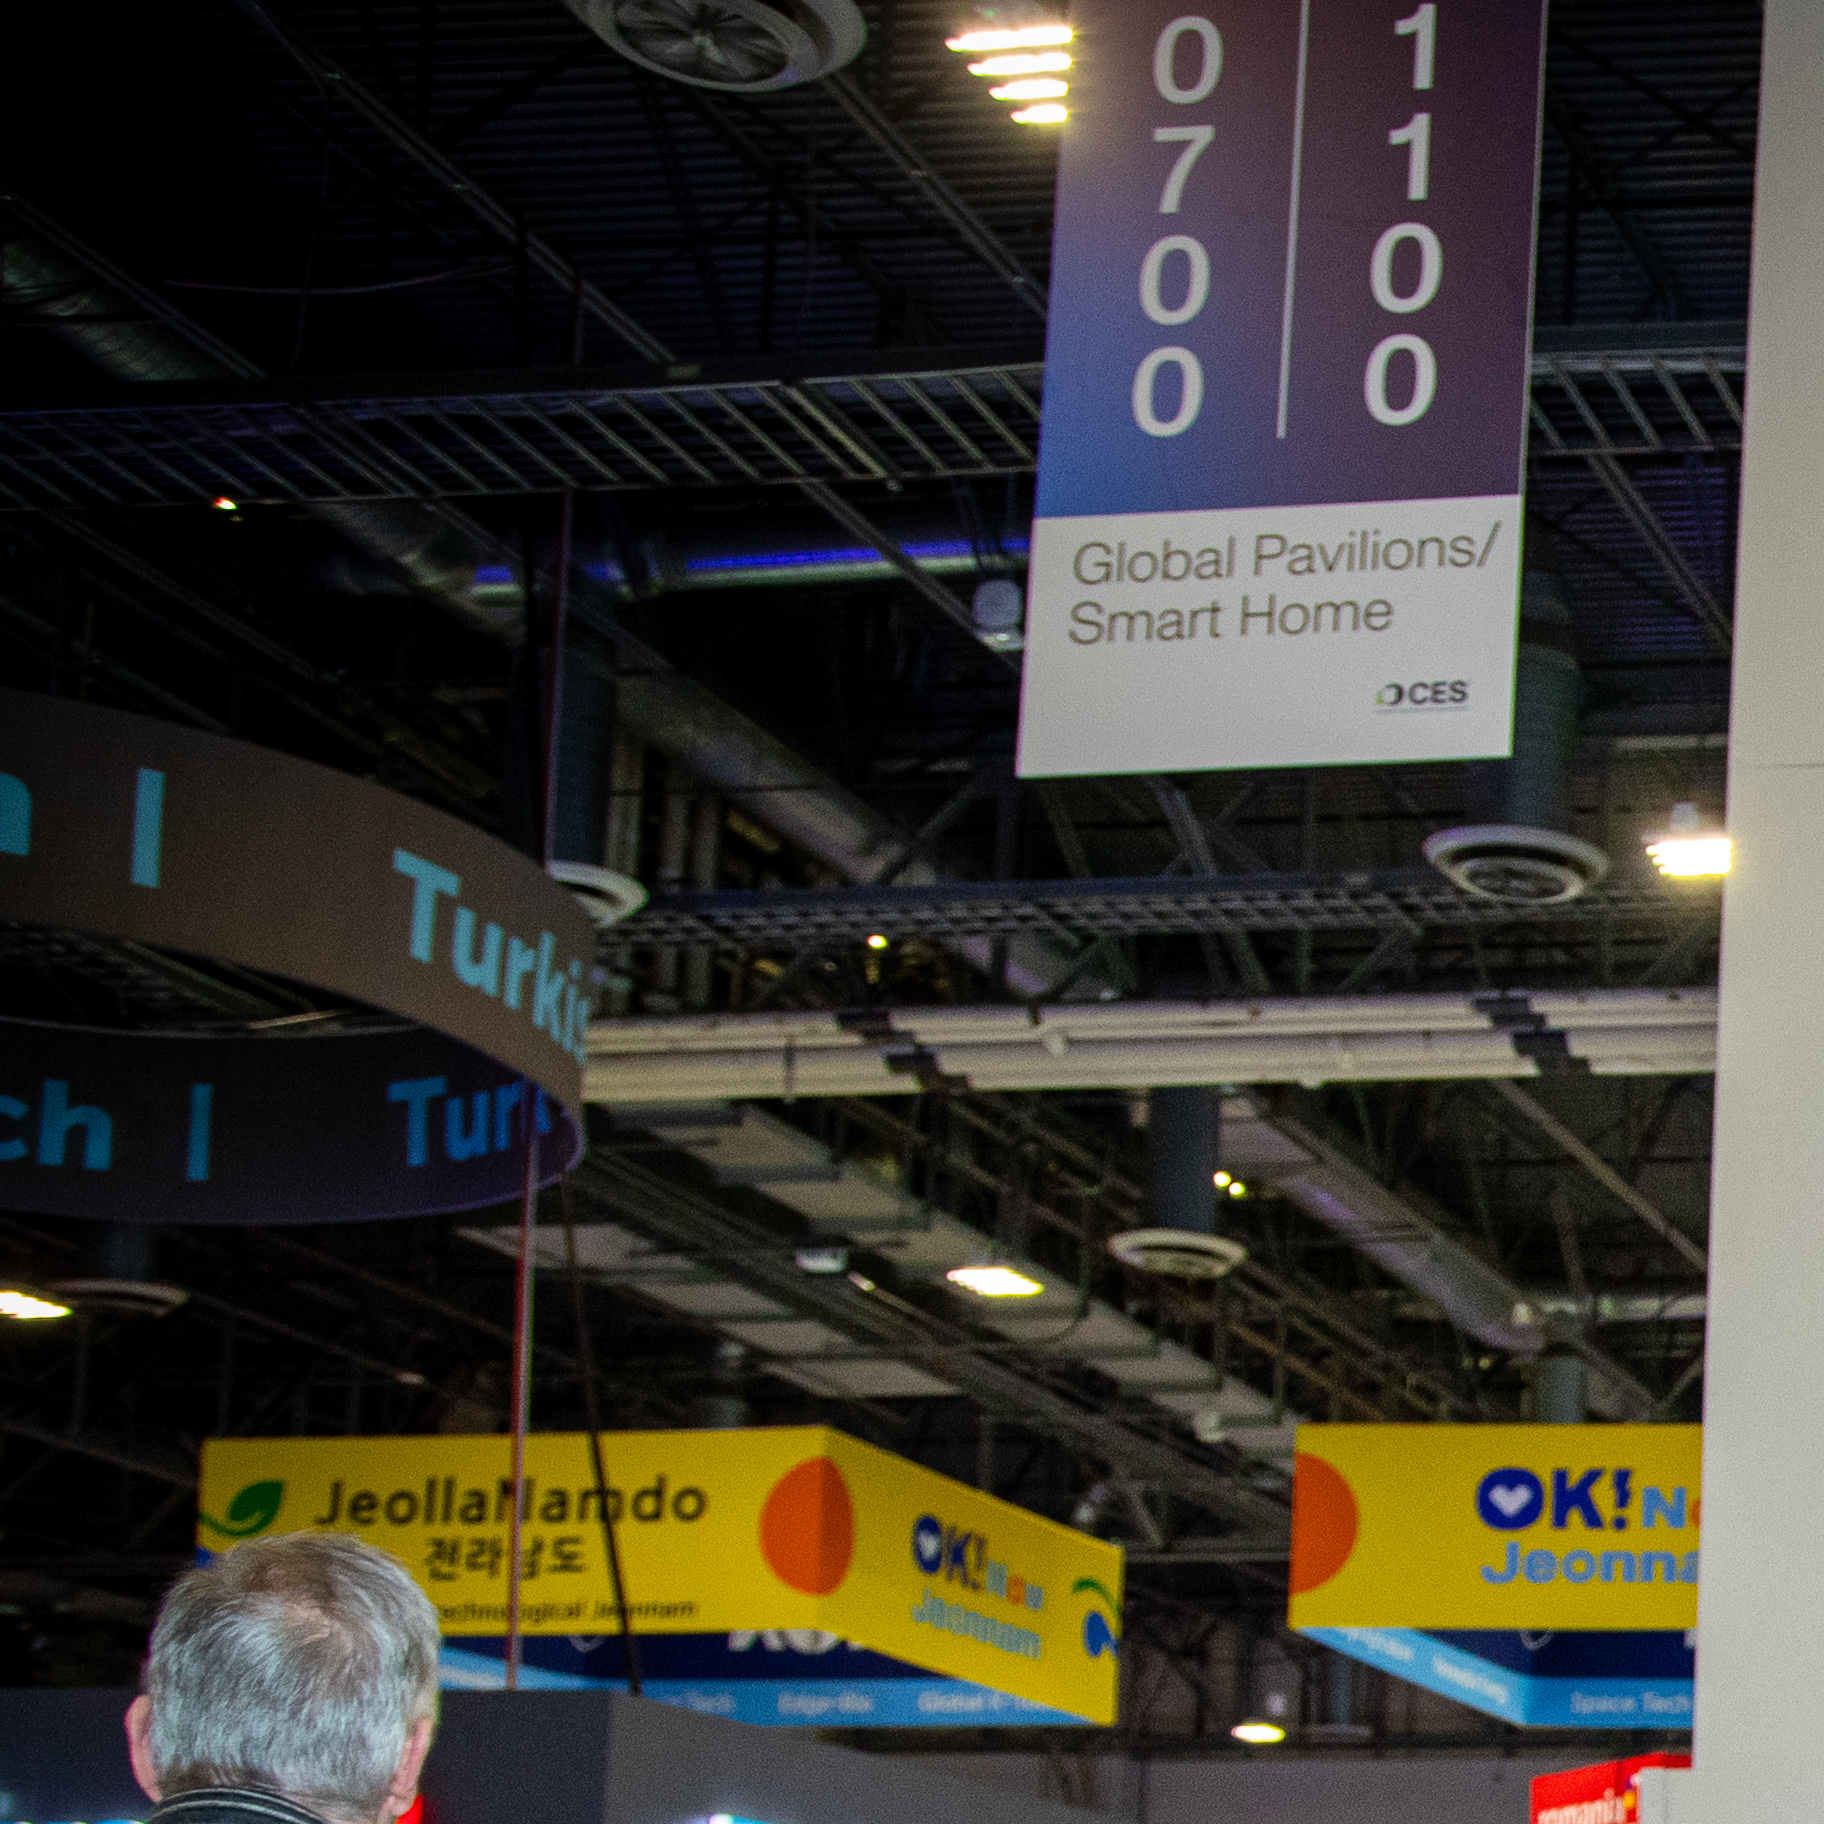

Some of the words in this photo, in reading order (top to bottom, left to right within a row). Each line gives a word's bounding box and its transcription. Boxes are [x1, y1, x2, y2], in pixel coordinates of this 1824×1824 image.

[1072, 535, 1237, 587] Global
[1253, 520, 1502, 577] Pavilions/
[1068, 600, 1224, 647] Smart
[1239, 593, 1395, 640] Home
[1407, 681, 1469, 705] CES
[1475, 1466, 1633, 1531] OK!
[1479, 1540, 1700, 1585] Jeonna
